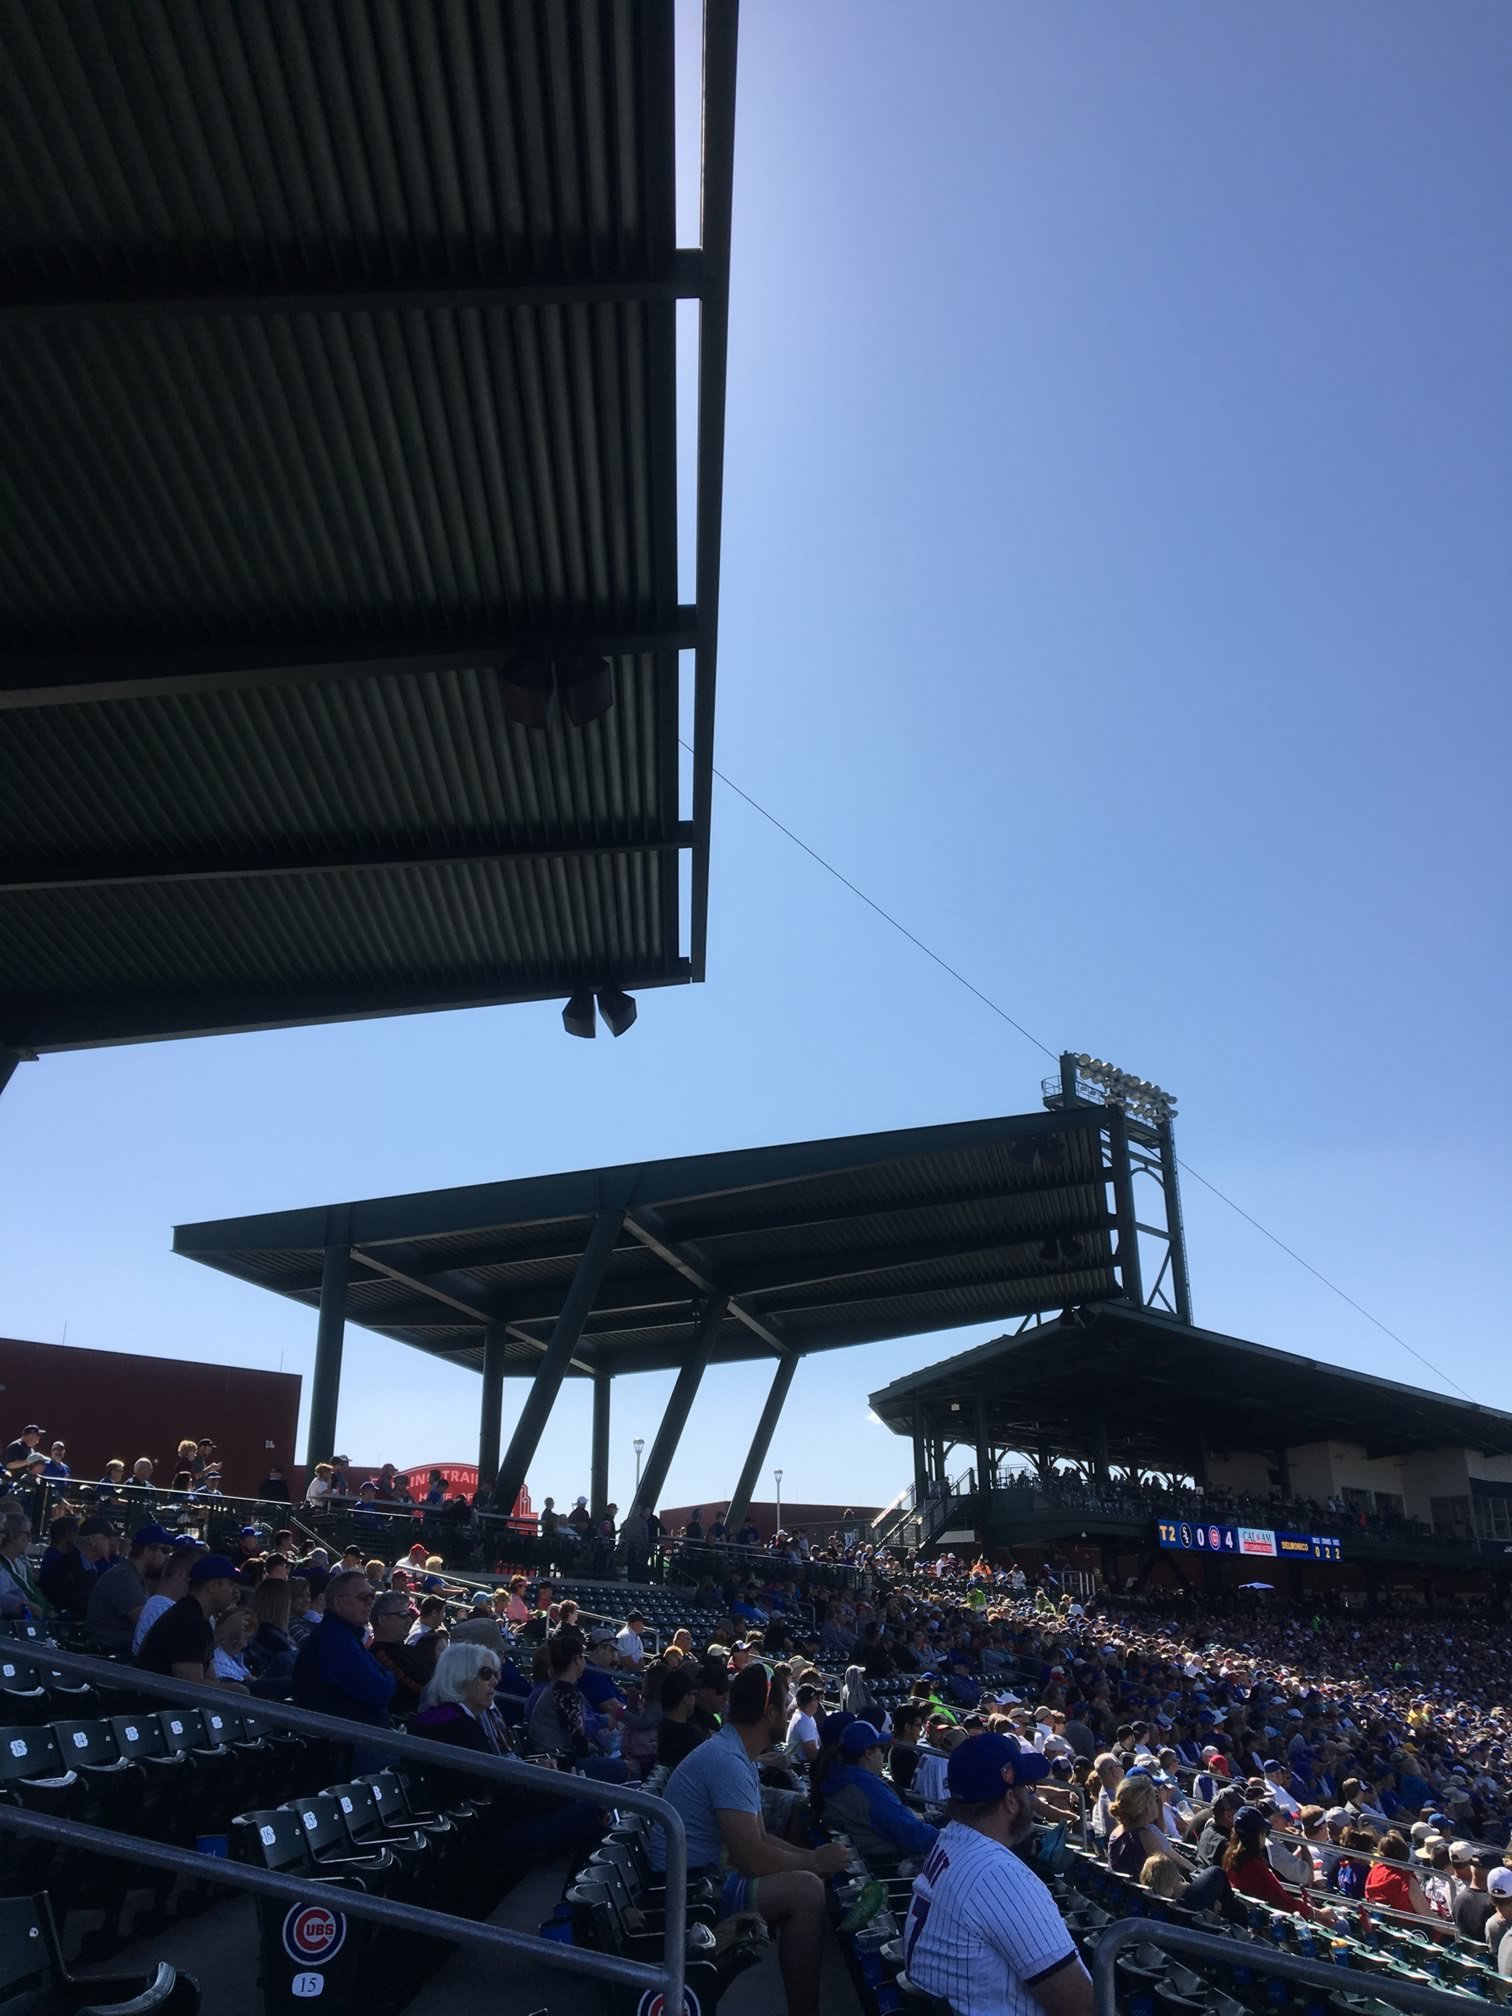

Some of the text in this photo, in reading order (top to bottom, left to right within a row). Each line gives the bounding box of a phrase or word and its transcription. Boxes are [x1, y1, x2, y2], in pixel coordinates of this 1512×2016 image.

[1197, 1527, 1205, 1547] 0
[1225, 1531, 1234, 1549] 4
[1315, 1546, 1341, 1560] 0 2 2
[295, 1907, 335, 1951] CUBS
[300, 1977, 316, 1993] 15
